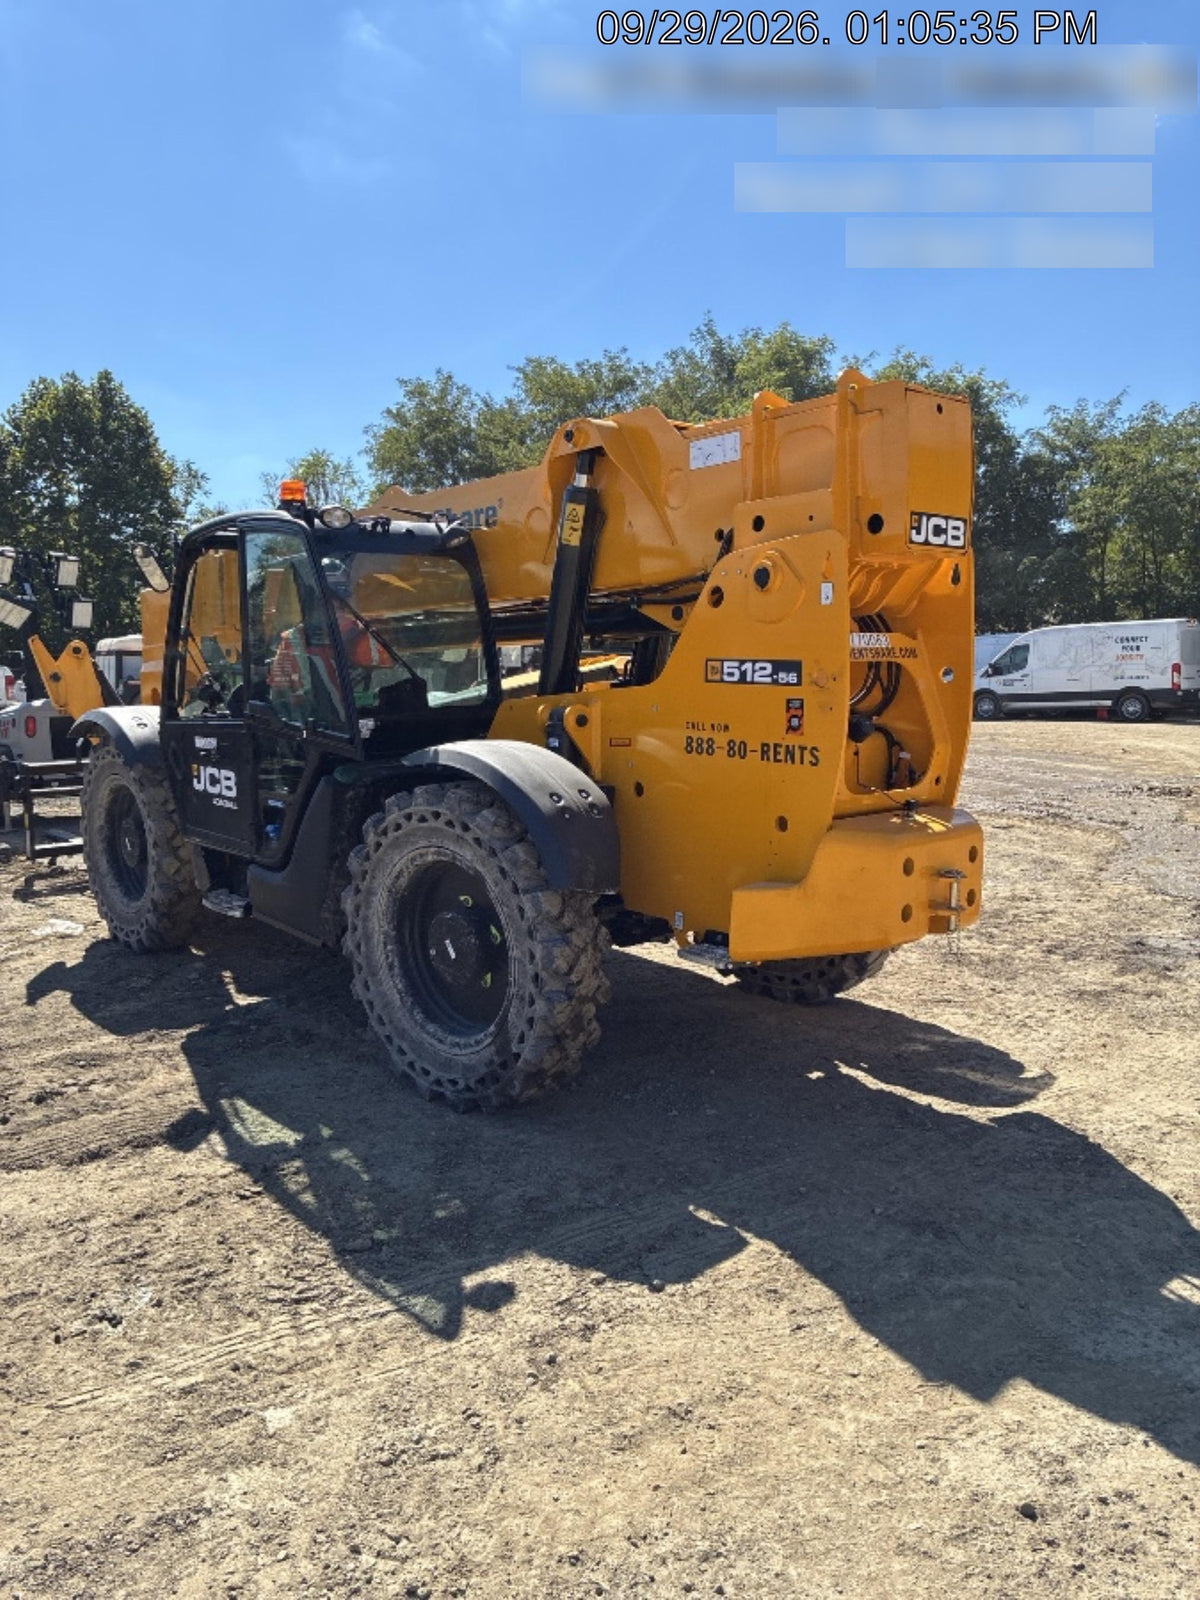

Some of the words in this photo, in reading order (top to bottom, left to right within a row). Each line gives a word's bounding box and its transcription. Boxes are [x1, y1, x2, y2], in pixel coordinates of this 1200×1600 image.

[910, 514, 965, 547] JCB
[685, 721, 707, 732] CALL
[710, 723, 730, 733] NOW
[684, 735, 821, 767] 888-80-RENTS
[192, 765, 238, 798] JCB
